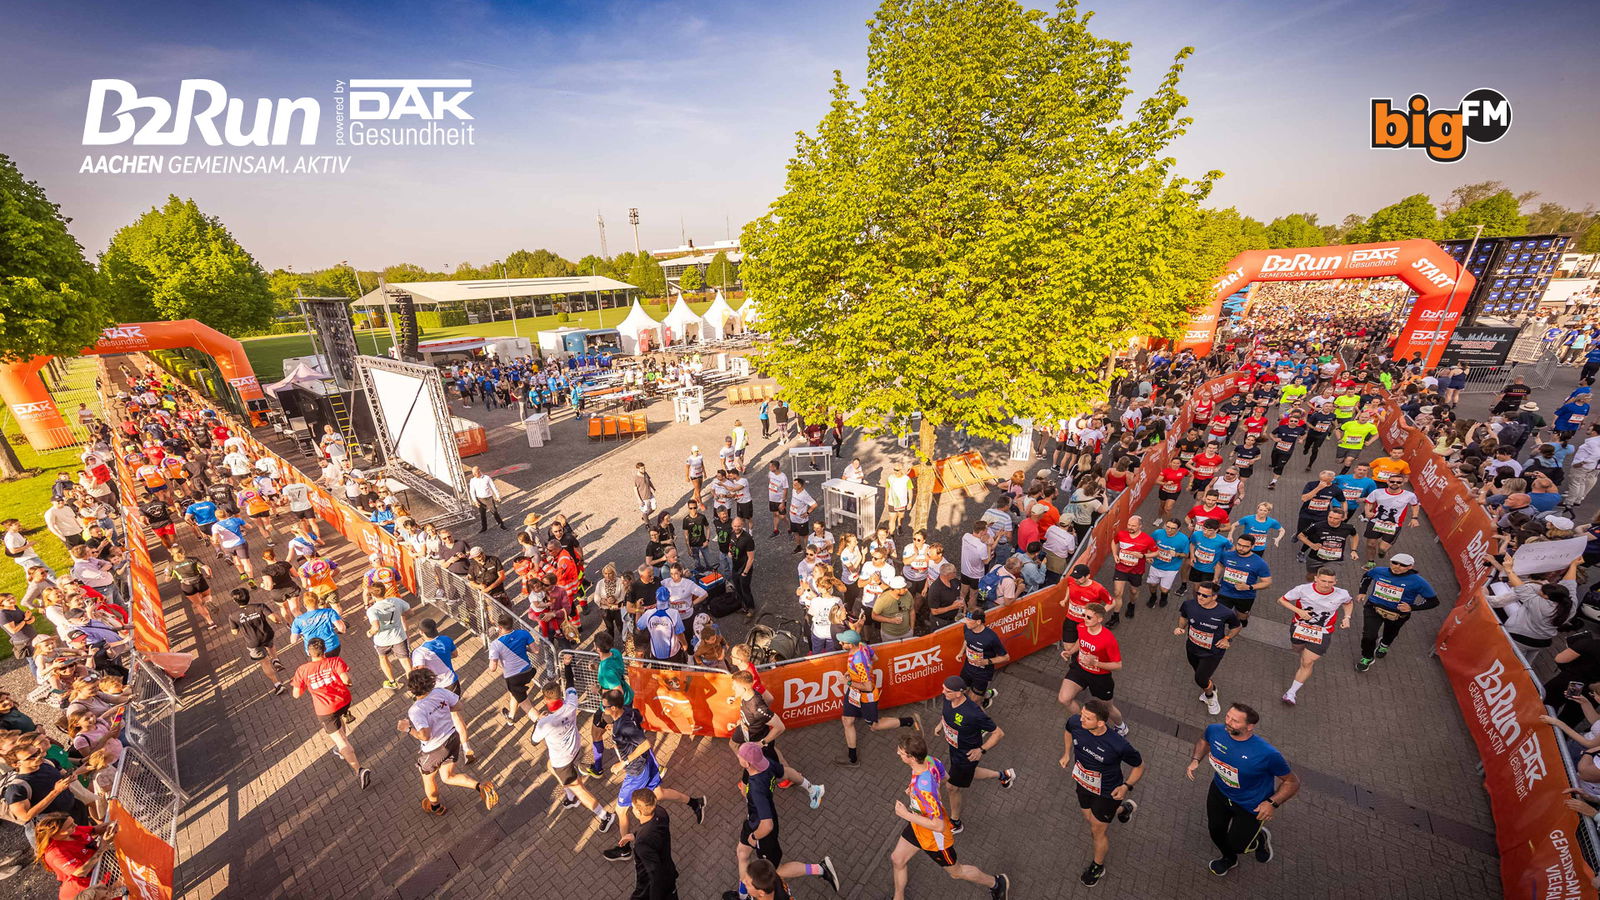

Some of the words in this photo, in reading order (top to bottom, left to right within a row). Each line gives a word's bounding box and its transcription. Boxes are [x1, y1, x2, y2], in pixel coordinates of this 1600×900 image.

[1261, 254, 1343, 273] B2Run
[1349, 260, 1397, 269] Gesundheit
[1352, 247, 1400, 262] DAK
[1310, 270, 1336, 278] AKTIV
[1411, 258, 1456, 288] START
[12, 400, 53, 415] DAK
[1001, 617, 1030, 634] VIELFALT
[1080, 639, 1096, 651] gmp
[894, 645, 943, 674] DAK
[894, 662, 944, 685] Gesundheit
[1474, 659, 1521, 747] B2Run
[1487, 706, 1506, 755] AKTIV
[1519, 732, 1547, 791] DAK
[1549, 829, 1581, 896] GEMEINSAM
[1546, 864, 1563, 900] VIELFAL
